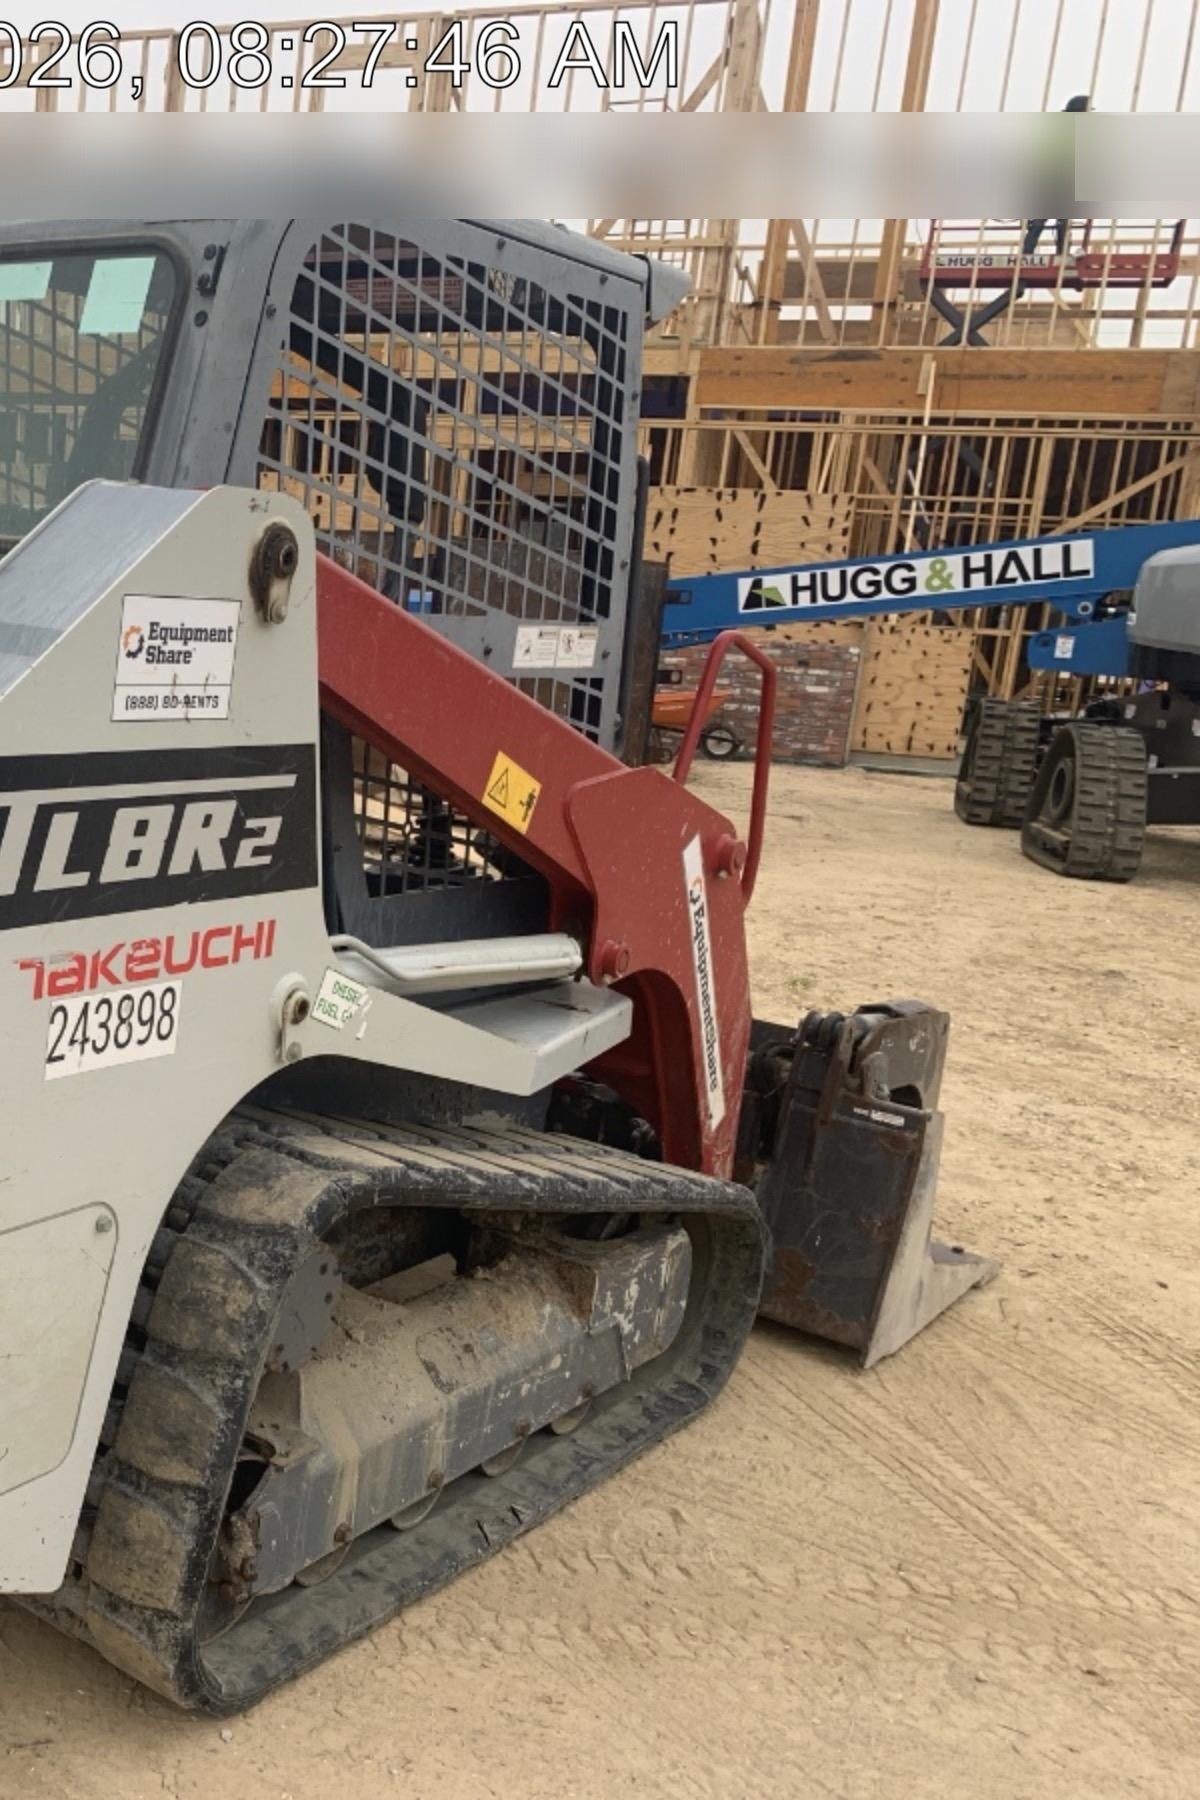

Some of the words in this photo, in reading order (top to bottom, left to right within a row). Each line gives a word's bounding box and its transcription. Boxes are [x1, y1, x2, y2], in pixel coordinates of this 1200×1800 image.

[790, 560, 918, 606] HUGG
[924, 558, 956, 592] &
[962, 543, 1091, 588] HALL
[147, 621, 234, 646] Equipment
[144, 645, 193, 665] Share
[124, 695, 159, 711] (888)
[45, 985, 177, 1065] 243898
